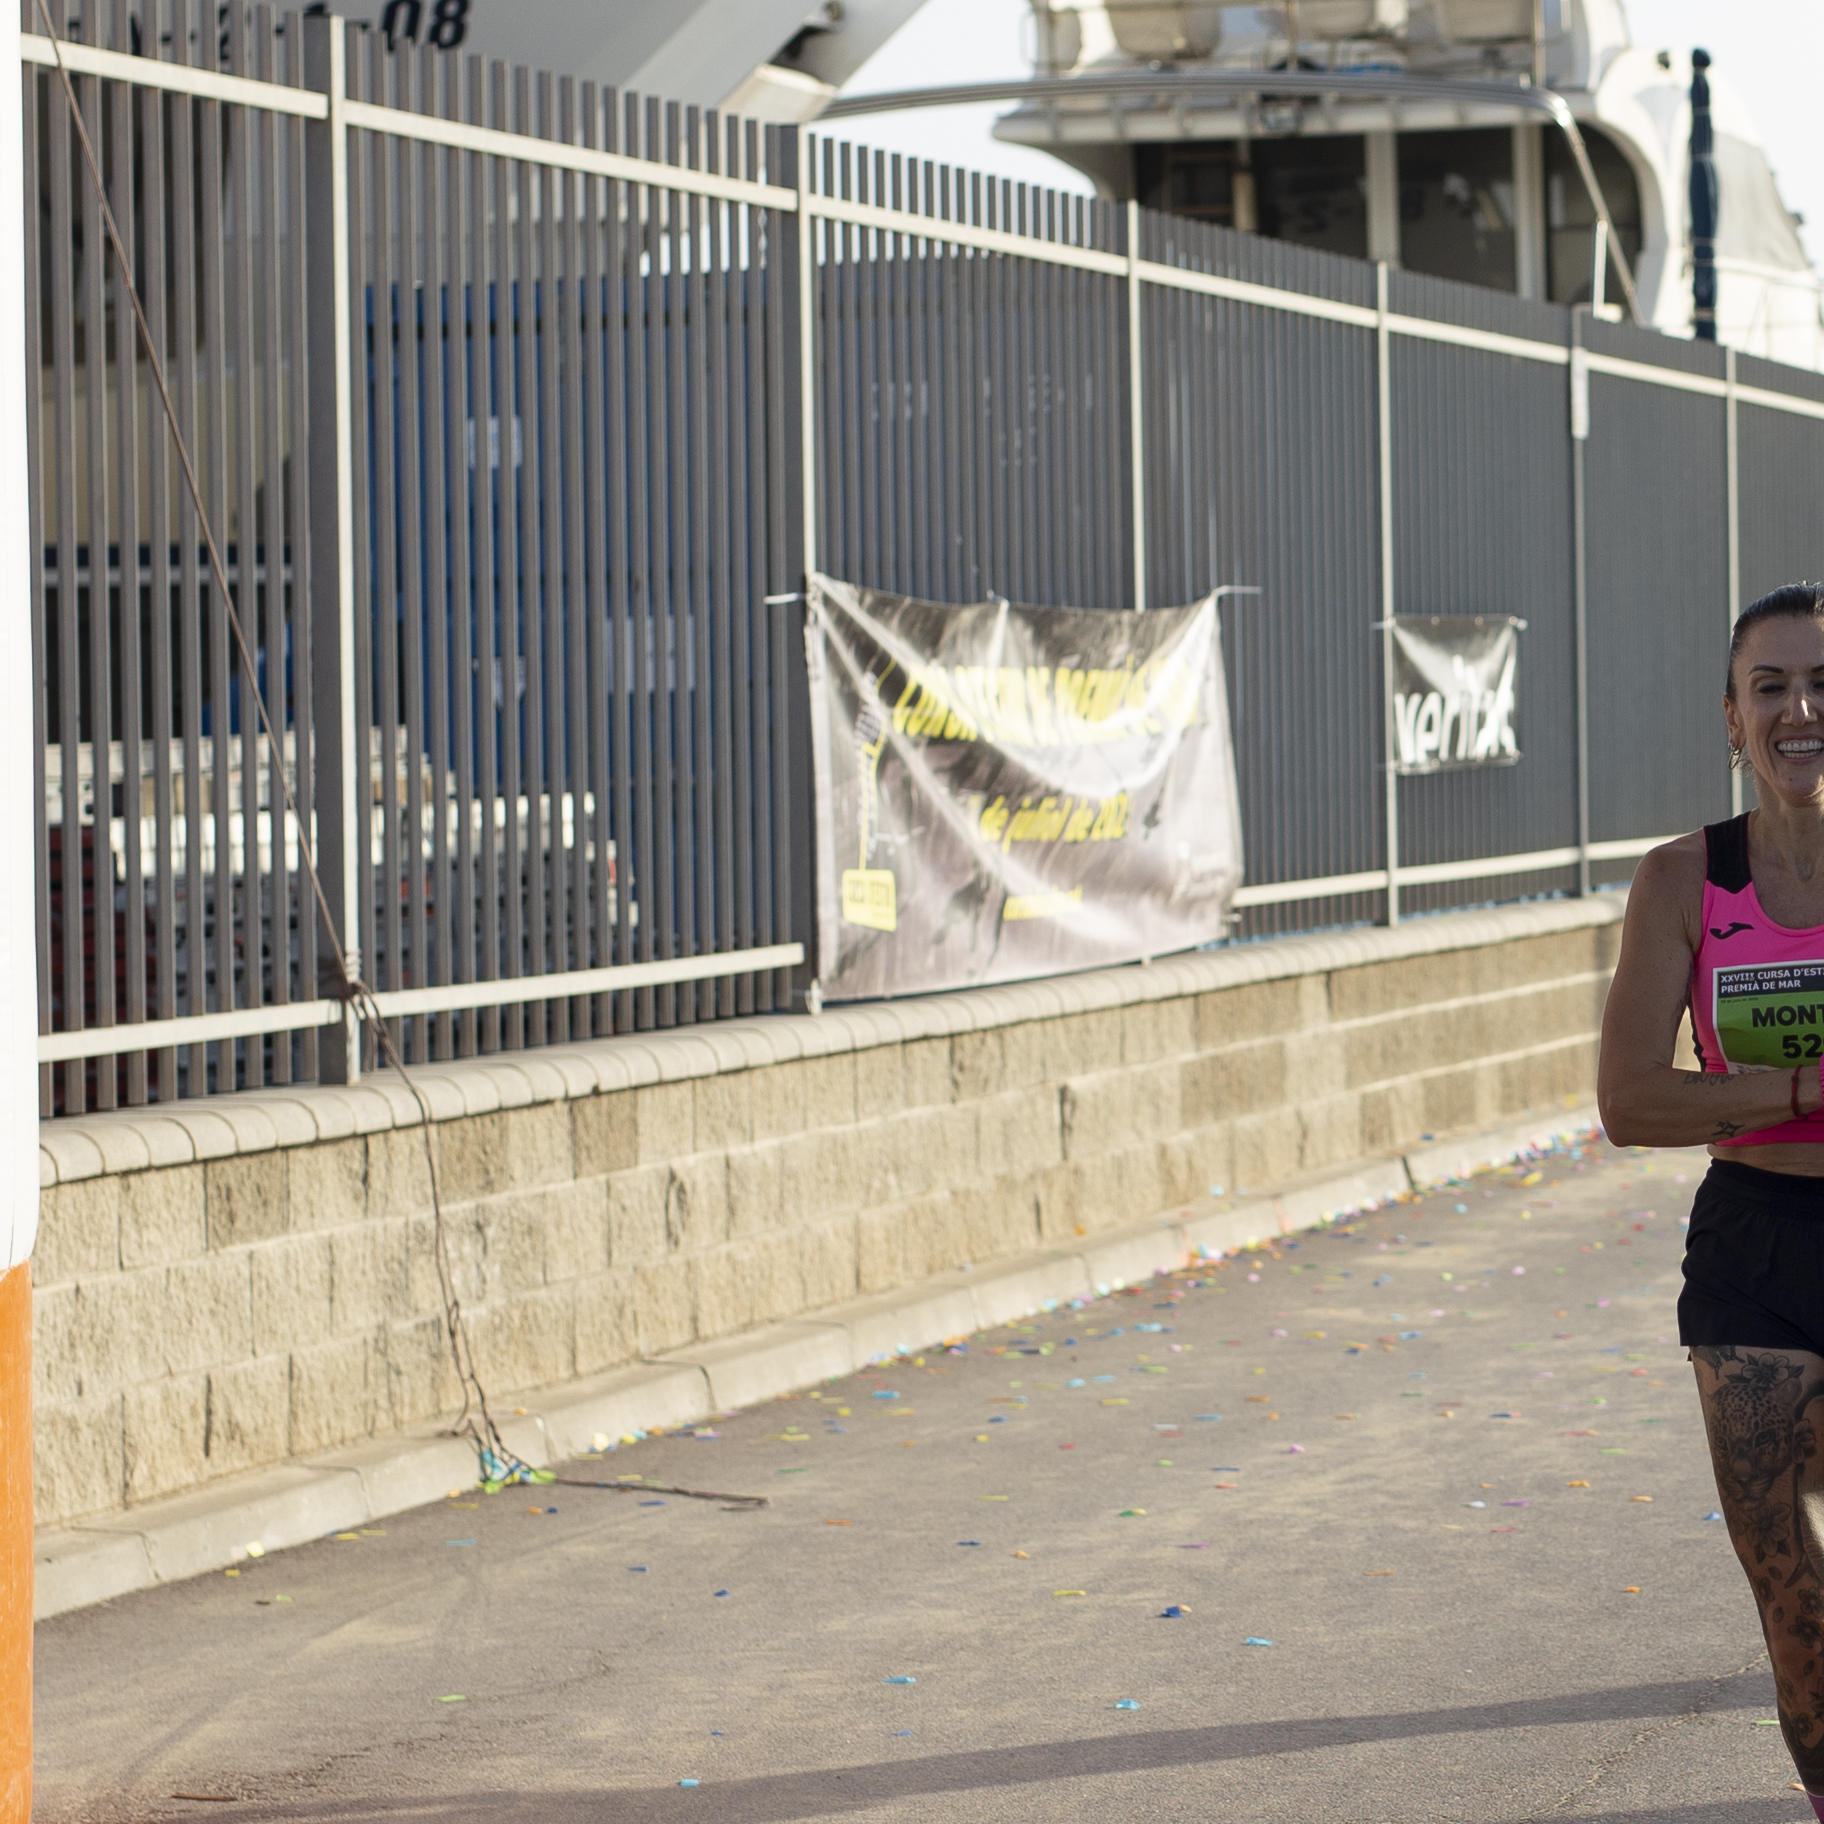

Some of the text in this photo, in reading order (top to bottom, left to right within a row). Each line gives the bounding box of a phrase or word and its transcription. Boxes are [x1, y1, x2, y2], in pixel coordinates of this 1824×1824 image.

[1757, 969, 1791, 980] CURSA
[1721, 978, 1801, 994] PREMIÀ DE MAR
